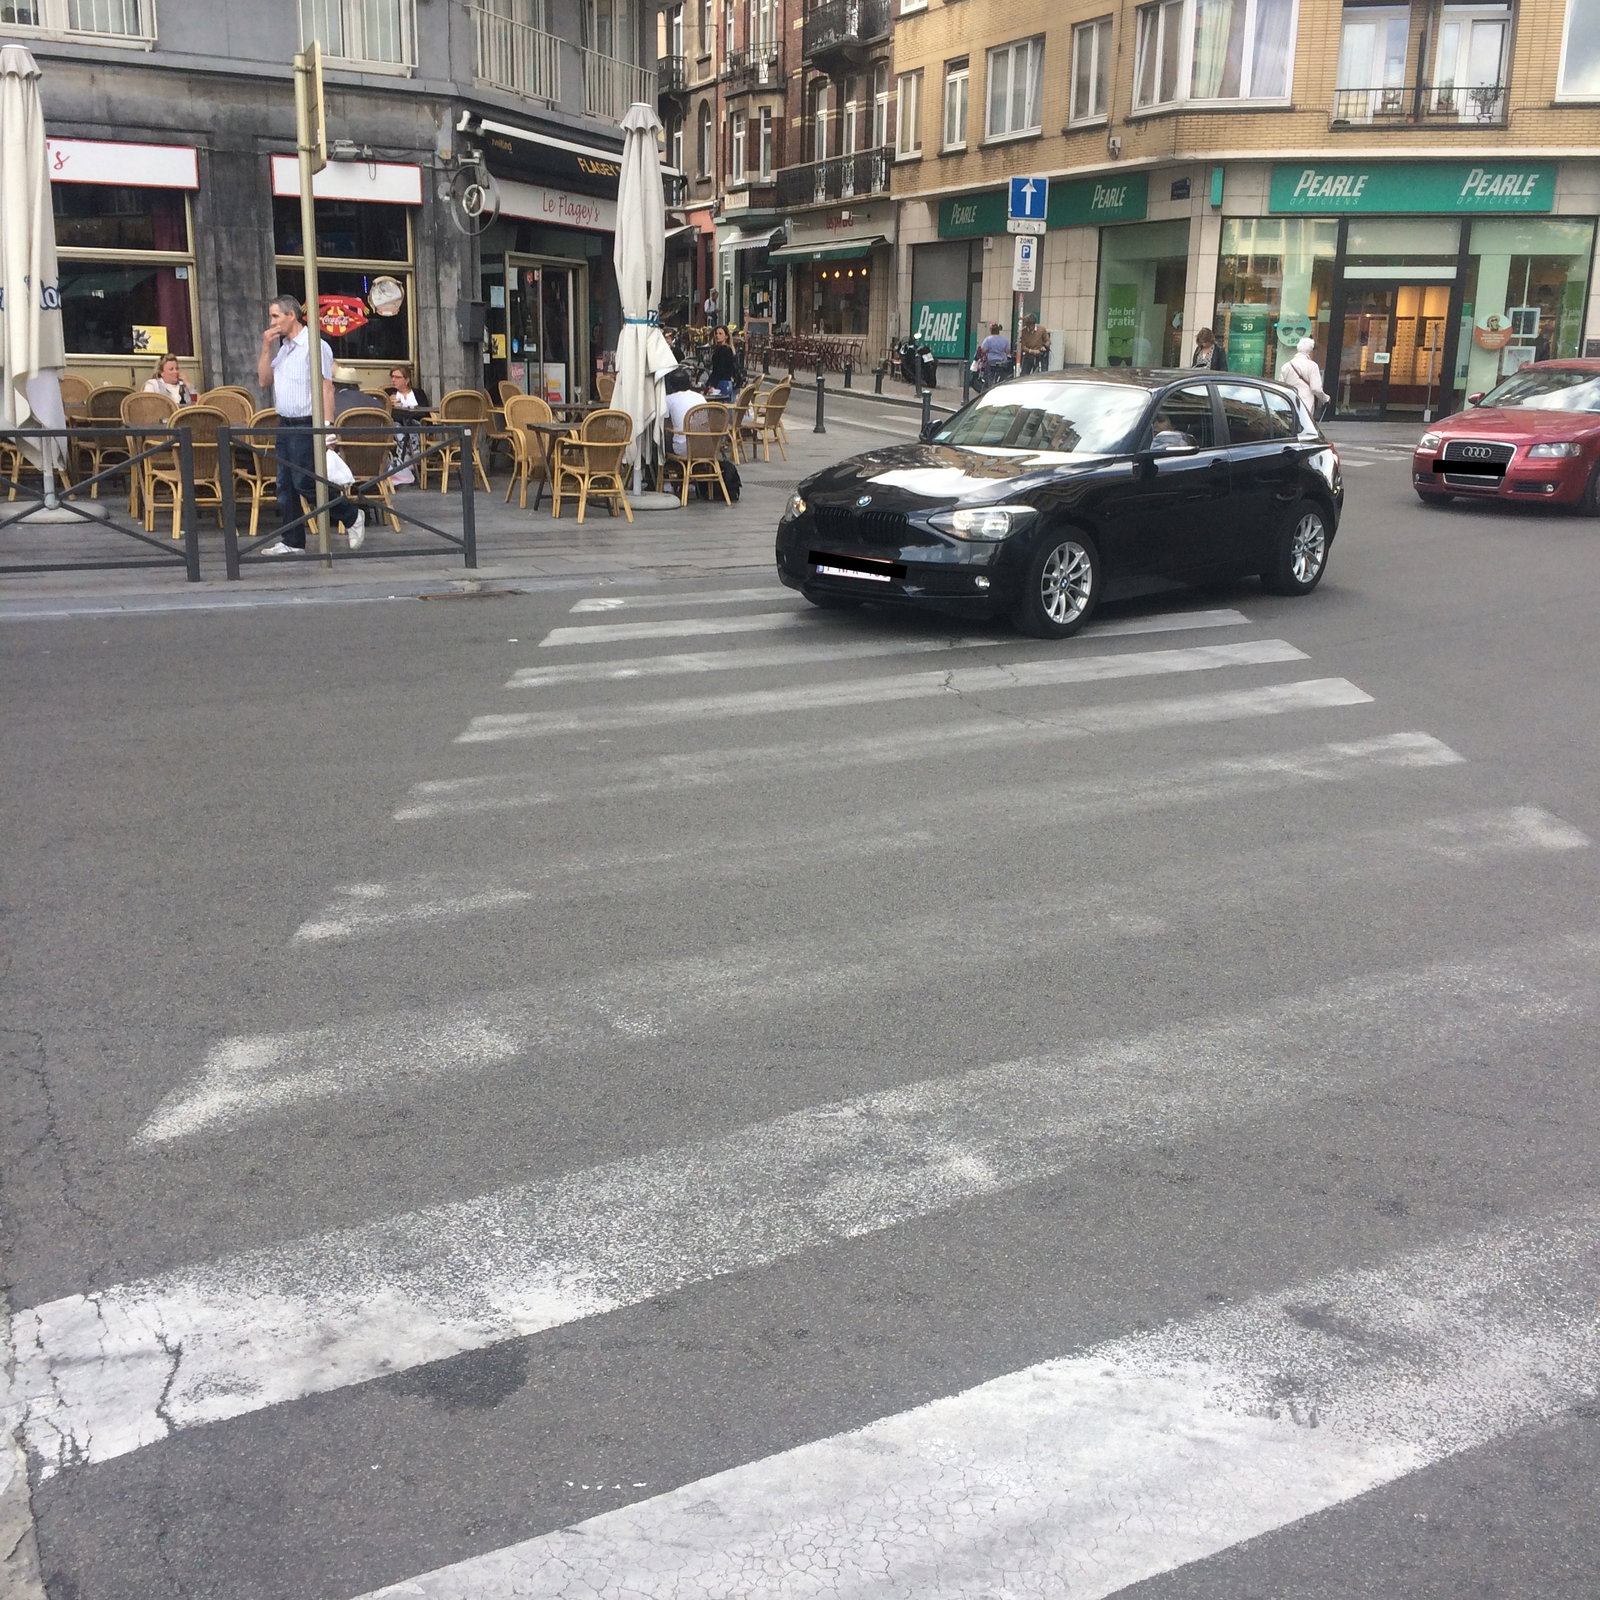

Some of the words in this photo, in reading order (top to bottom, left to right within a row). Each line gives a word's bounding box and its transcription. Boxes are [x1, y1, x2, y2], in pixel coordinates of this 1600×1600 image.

[1293, 169, 1369, 197] PEARLE
[1460, 168, 1540, 196] PEARLE
[543, 192, 556, 213] Le
[558, 194, 601, 225] Flagey's
[1091, 184, 1128, 210] PEARLE
[1289, 197, 1360, 206] OPTICIENS
[1456, 196, 1530, 205] OPTICIENS
[950, 203, 977, 227] PEARLE
[917, 305, 962, 341] PEARLE
[1107, 316, 1135, 329] gratis
